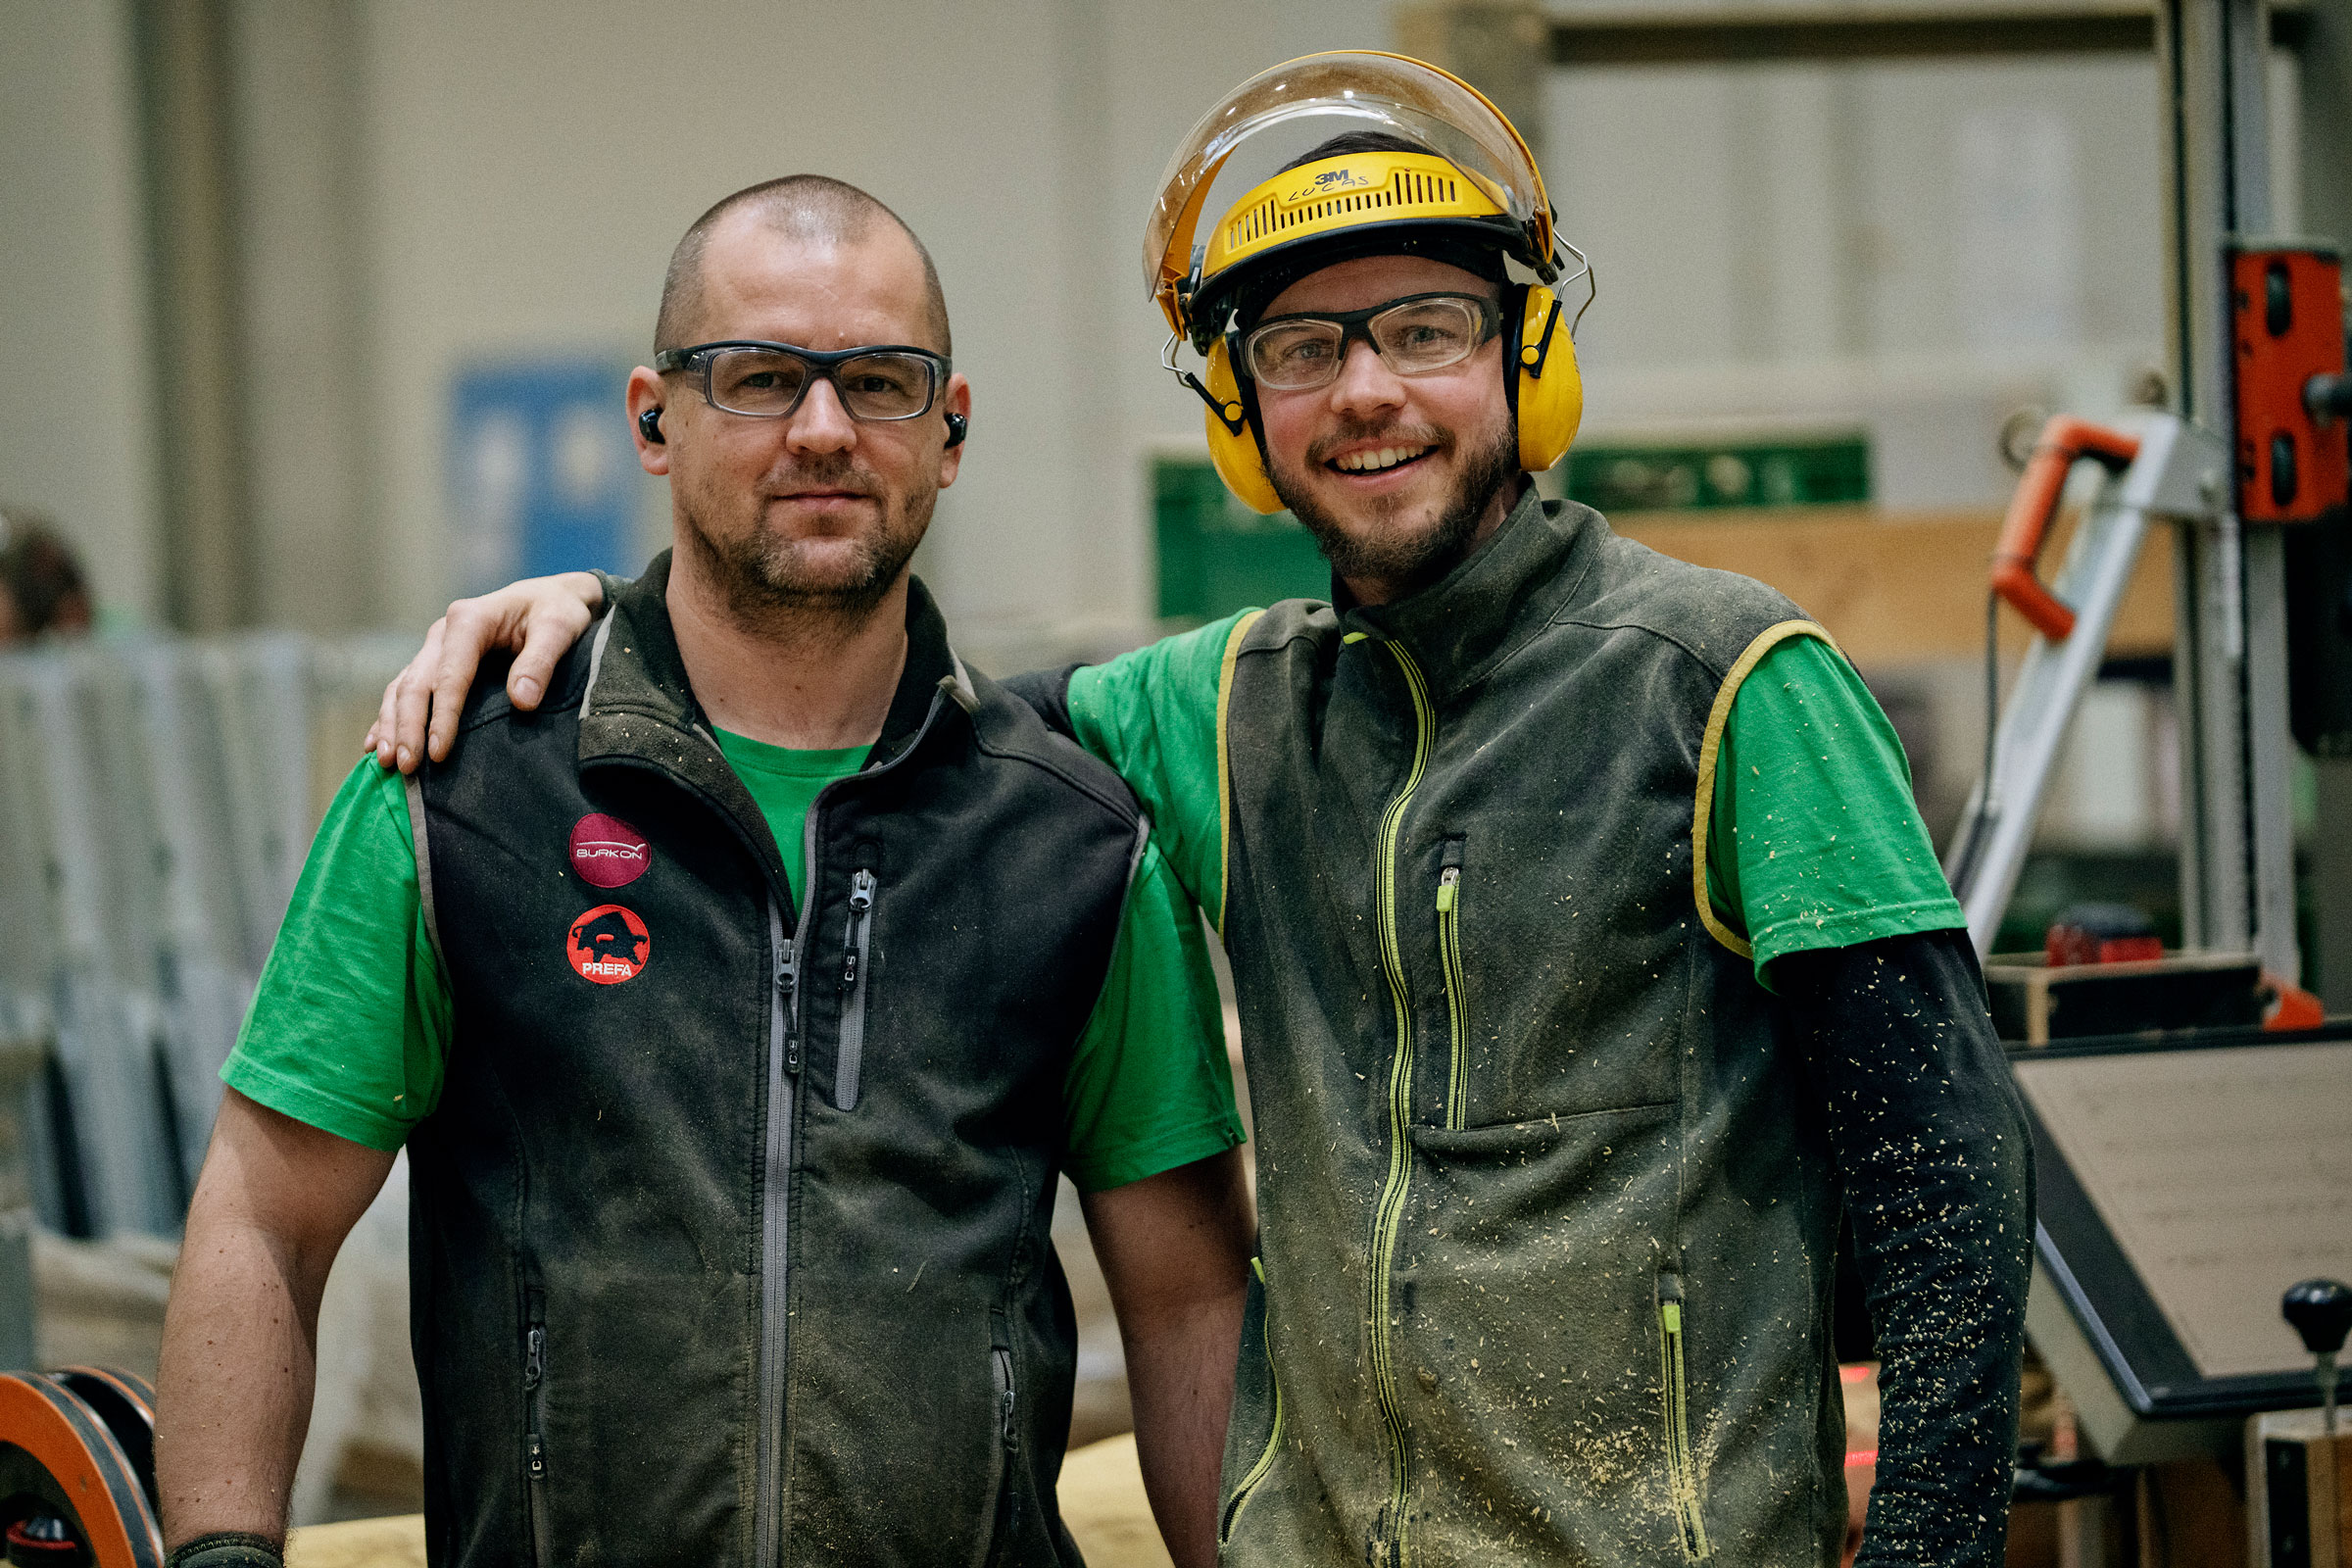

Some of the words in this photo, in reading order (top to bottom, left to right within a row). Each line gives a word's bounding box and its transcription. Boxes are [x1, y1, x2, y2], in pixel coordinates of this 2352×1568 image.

[1314, 170, 1349, 185] 3M
[1288, 176, 1369, 202] LUCAS
[576, 849, 643, 859] BURKON
[582, 962, 632, 977] PREFA
